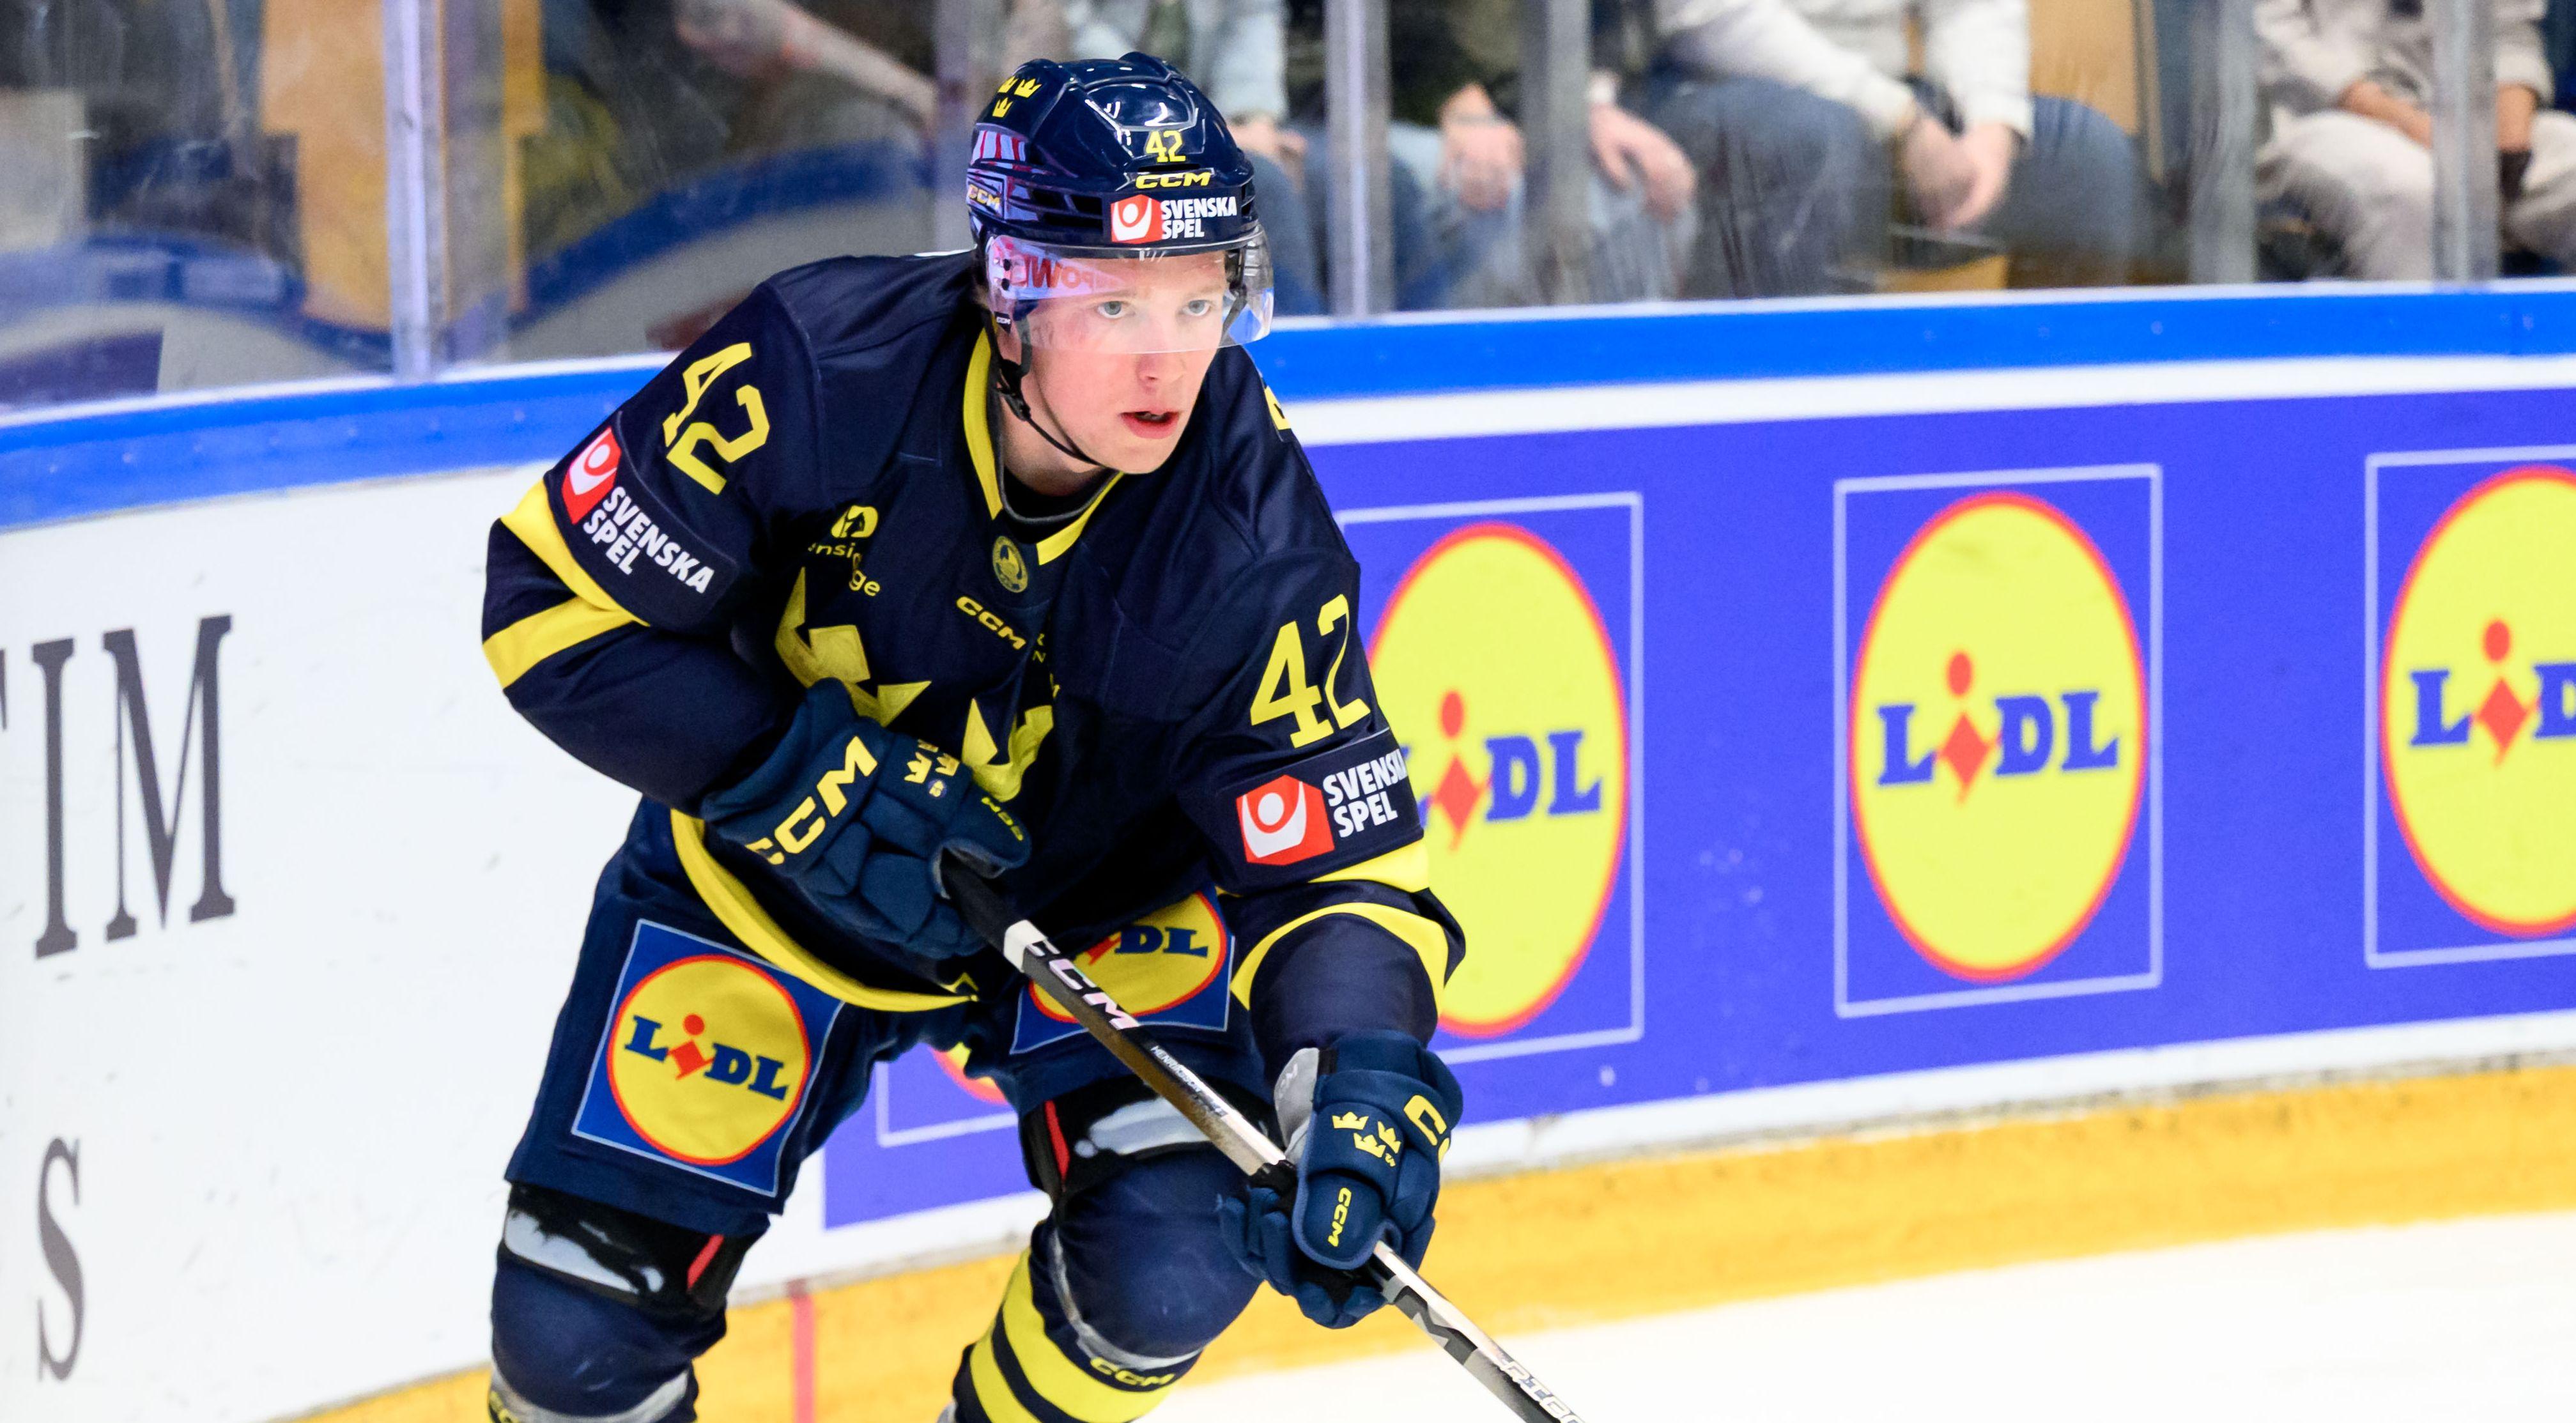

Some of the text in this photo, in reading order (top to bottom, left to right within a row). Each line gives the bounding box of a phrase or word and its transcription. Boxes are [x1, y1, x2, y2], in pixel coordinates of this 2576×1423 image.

[1146, 130, 1186, 163] 42
[968, 184, 1001, 209] CCM
[1135, 172, 1212, 189] CCM
[1160, 196, 1238, 220] SVENSKA
[1161, 219, 1205, 240] SPEL
[663, 342, 770, 495] 42
[583, 509, 640, 575] SPEL
[603, 486, 714, 594] SVENSKA
[956, 596, 1026, 650] CCM
[1250, 594, 1370, 748] 42
[0, 613, 236, 960] IM
[1333, 791, 1398, 838] SPEL
[1328, 1187, 1352, 1247] CCM
[1090, 1357, 1175, 1387] CCM
